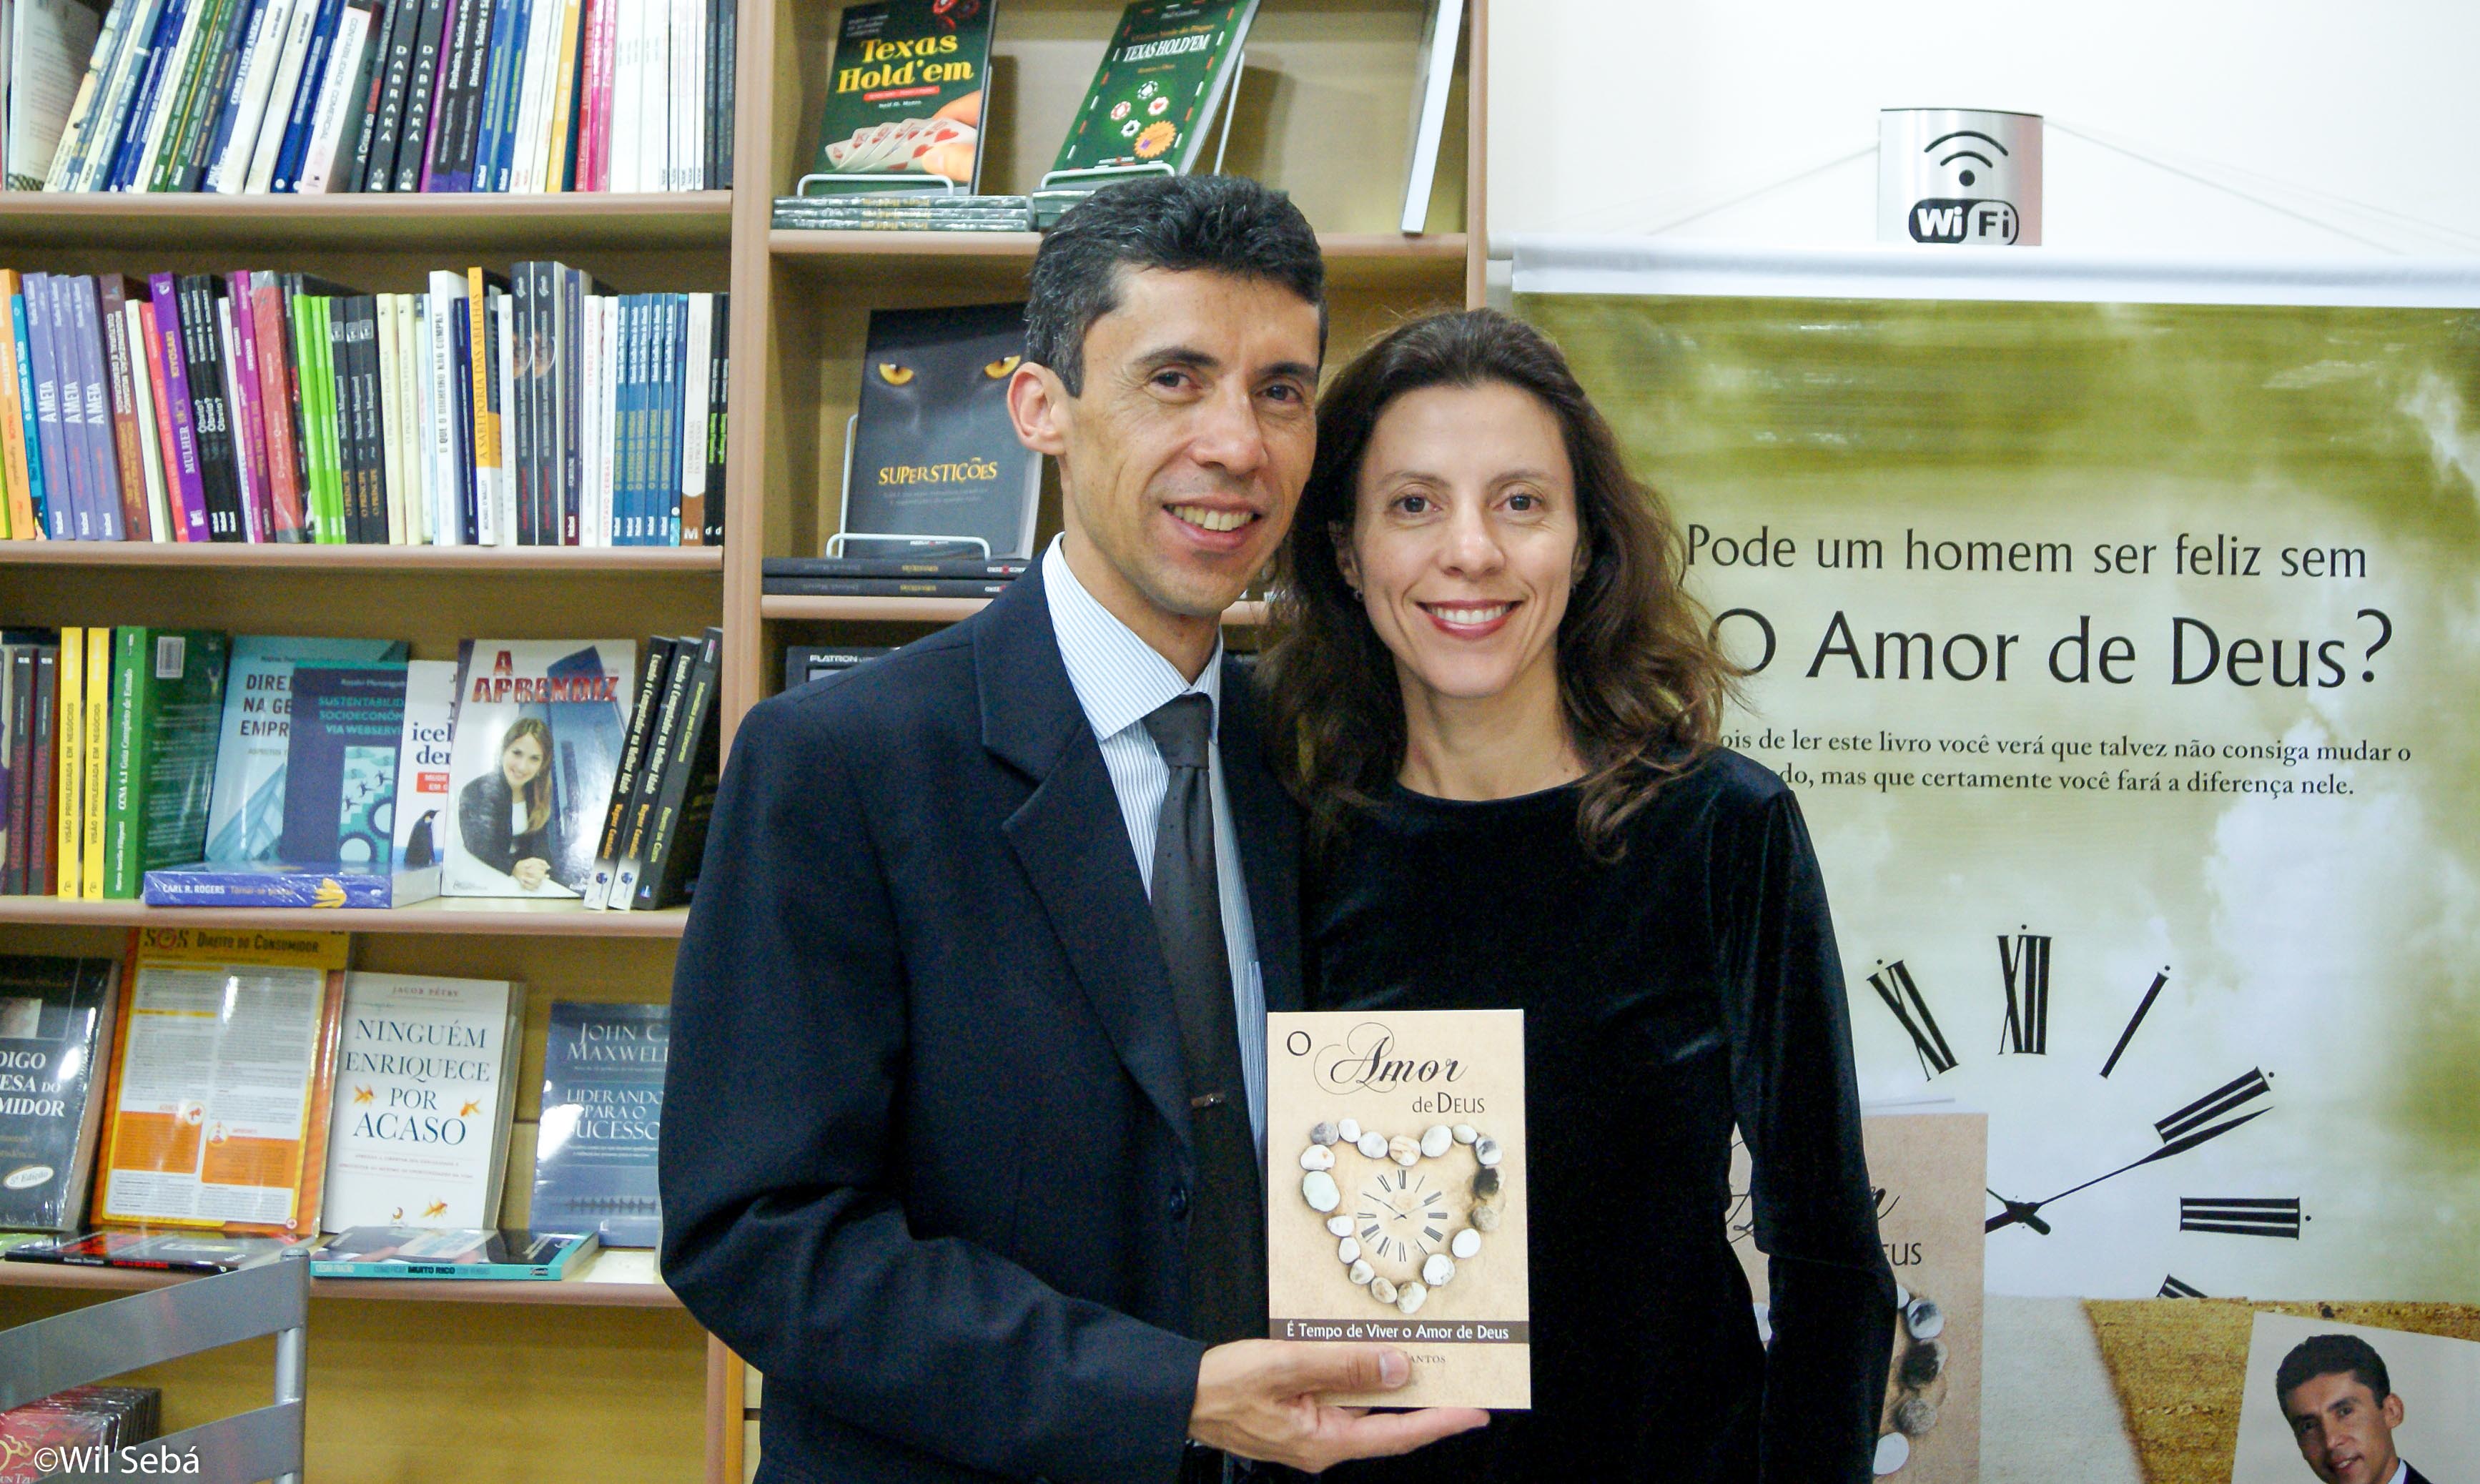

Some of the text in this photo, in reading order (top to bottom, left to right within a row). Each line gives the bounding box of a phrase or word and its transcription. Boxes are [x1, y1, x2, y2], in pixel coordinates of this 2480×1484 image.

[861, 34, 958, 63] Texas
[1122, 34, 1211, 63] TEXAS HOLD'EM
[836, 59, 974, 94] Hold'em
[434, 312, 443, 350] COMPRA
[435, 352, 444, 370] NÃO
[471, 292, 488, 458] A SABEDORIA DAS ABELHAS
[39, 380, 57, 423] A META
[62, 381, 82, 424] A META
[86, 382, 104, 425] A META
[437, 373, 446, 415] DINHEIRO
[179, 426, 196, 473] MULHER
[438, 426, 448, 444] QUE
[879, 457, 998, 486] SUPERSTIÇÕES
[1689, 524, 2367, 578] Pode um homem ser feliz sem
[809, 653, 859, 665] FLATRON
[1708, 607, 2393, 688] O Amor de Deus?
[493, 650, 513, 676] A
[123, 668, 134, 698] Estudo
[472, 676, 620, 703] APRENDIZ
[122, 698, 132, 709] de
[244, 697, 266, 713] NA
[120, 711, 132, 748] Completo
[326, 724, 344, 736] VIA
[119, 748, 129, 770] Guia
[1719, 728, 2411, 766] ois de ler este livro você verá que talvez não consiga mudar o
[64, 702, 74, 844] VISÃO PRIVILEGIADA EM NEGÓCIOS
[89, 702, 101, 845] VISÃO PRIVILEGIADA EM NEGÓCIOS
[1776, 763, 2354, 800] do, mas que certamente você fará a diferença nele.
[118, 786, 129, 811] CCNA
[162, 884, 182, 894] CARL
[184, 885, 193, 894] R.
[194, 885, 225, 895] ROGERS
[355, 1019, 488, 1049] NINGUÉM
[579, 1022, 670, 1046] JOHN C.
[1286, 1031, 1312, 1057] O
[345, 1052, 491, 1084] ENRIQUECE
[1313, 1022, 1468, 1095] Amor
[388, 1087, 438, 1110] POR
[585, 1104, 647, 1120] PARA O
[1412, 1092, 1486, 1114] de DEUS
[352, 1112, 467, 1146] ACASO
[572, 1119, 661, 1141] UCESSO
[1286, 1320, 1509, 1341] É Tempo de Viver o Amor de Deus
[1404, 1350, 1446, 1363] ANTOS
